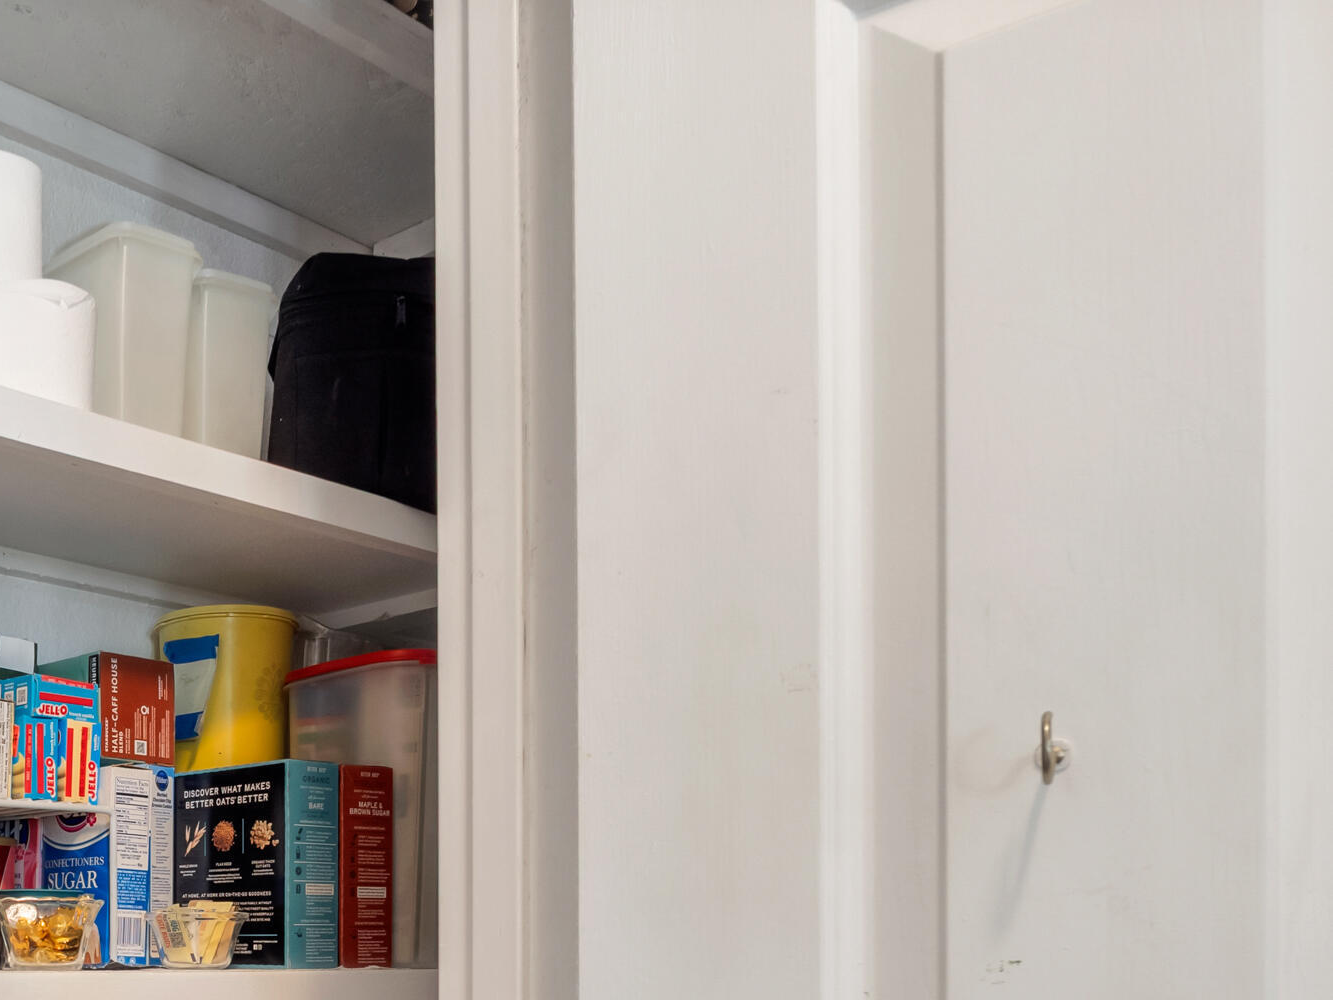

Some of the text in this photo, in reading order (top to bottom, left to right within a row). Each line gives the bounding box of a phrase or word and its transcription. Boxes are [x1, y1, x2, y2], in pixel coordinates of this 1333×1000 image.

[111, 657, 119, 753] HALF-CAFF HOUSE
[184, 781, 271, 799] DISCOVER WHAT MAKES
[185, 798, 214, 810] BETTER
[237, 793, 269, 804] BETTER
[358, 801, 377, 809] MAPLE
[349, 807, 371, 815] BROWN
[45, 856, 105, 869] CONFECTIONERS
[47, 870, 99, 890] SUGAR
